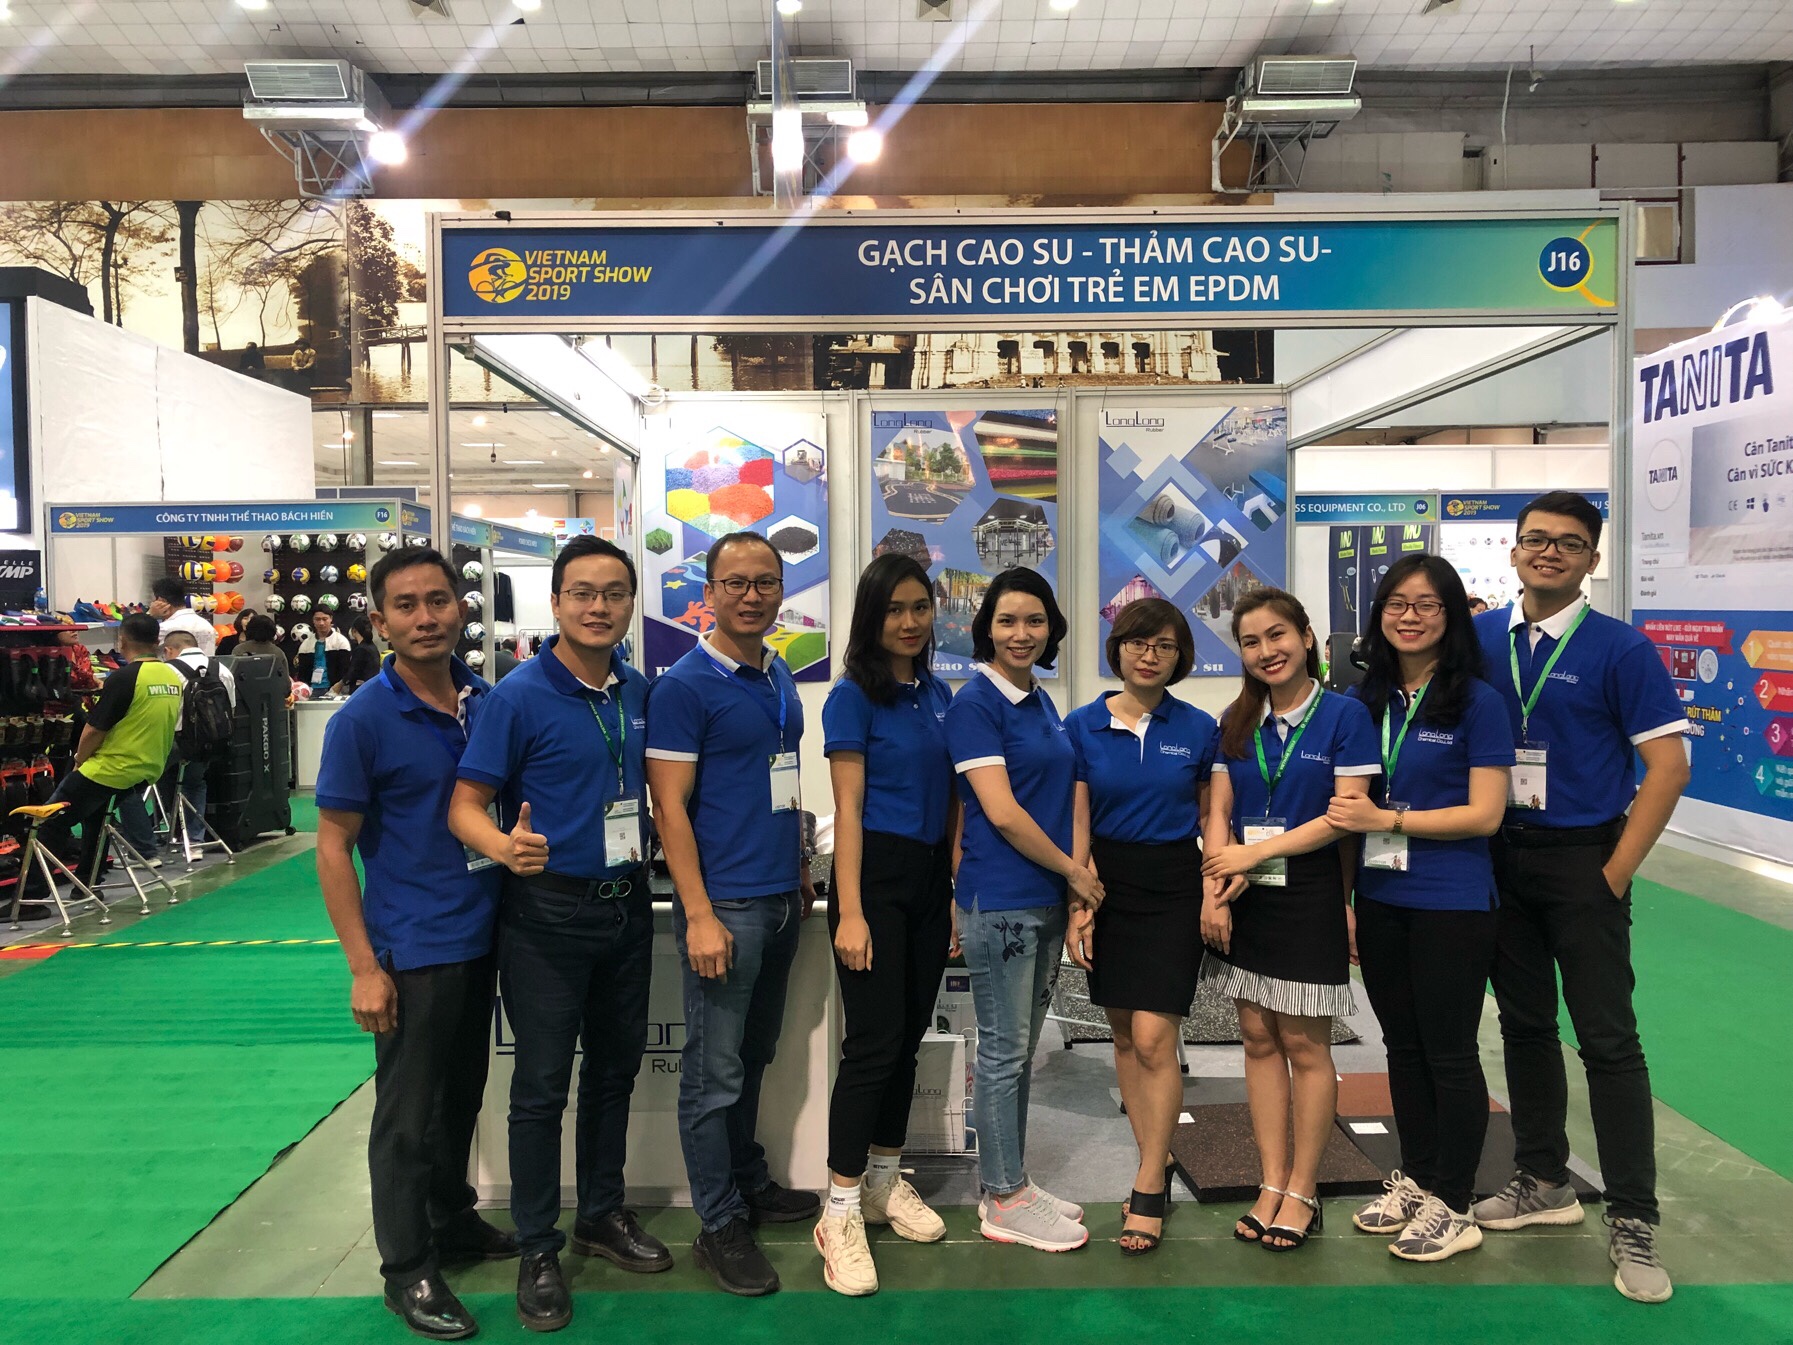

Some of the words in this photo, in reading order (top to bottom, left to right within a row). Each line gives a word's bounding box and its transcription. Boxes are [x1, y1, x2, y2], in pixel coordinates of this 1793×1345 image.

[525, 250, 607, 265] VIETNAM
[858, 239, 947, 273] GẠCH
[956, 238, 1024, 266] CAO
[1033, 238, 1073, 265] SU
[1099, 229, 1194, 264] THẢM
[1202, 236, 1270, 263] CAO
[1547, 251, 1581, 272] J16
[528, 266, 591, 283] SPORT
[594, 266, 653, 283] SHOW
[525, 285, 571, 300] 2019
[910, 272, 972, 304] SÂN
[982, 274, 1060, 304] CHƠI
[1067, 268, 1125, 303] TRẺ
[1134, 276, 1180, 302] EM
[1190, 274, 1280, 302] EPDM
[1640, 331, 1774, 423] TANITA
[1744, 440, 1764, 457] Cân
[1727, 467, 1747, 482] Cân
[1308, 503, 1365, 513] EQUIPMENT
[1388, 502, 1406, 512] LTD
[156, 512, 185, 523] CÔNG
[188, 513, 199, 522] TY
[201, 512, 229, 522] TNHH
[251, 511, 279, 521] THAO
[281, 510, 308, 521] BÁCH
[1748, 640, 1755, 658] 1
[1203, 663, 1224, 672] su
[1759, 679, 1769, 699] 2
[1771, 723, 1781, 743] 3
[1755, 765, 1765, 784] 4
